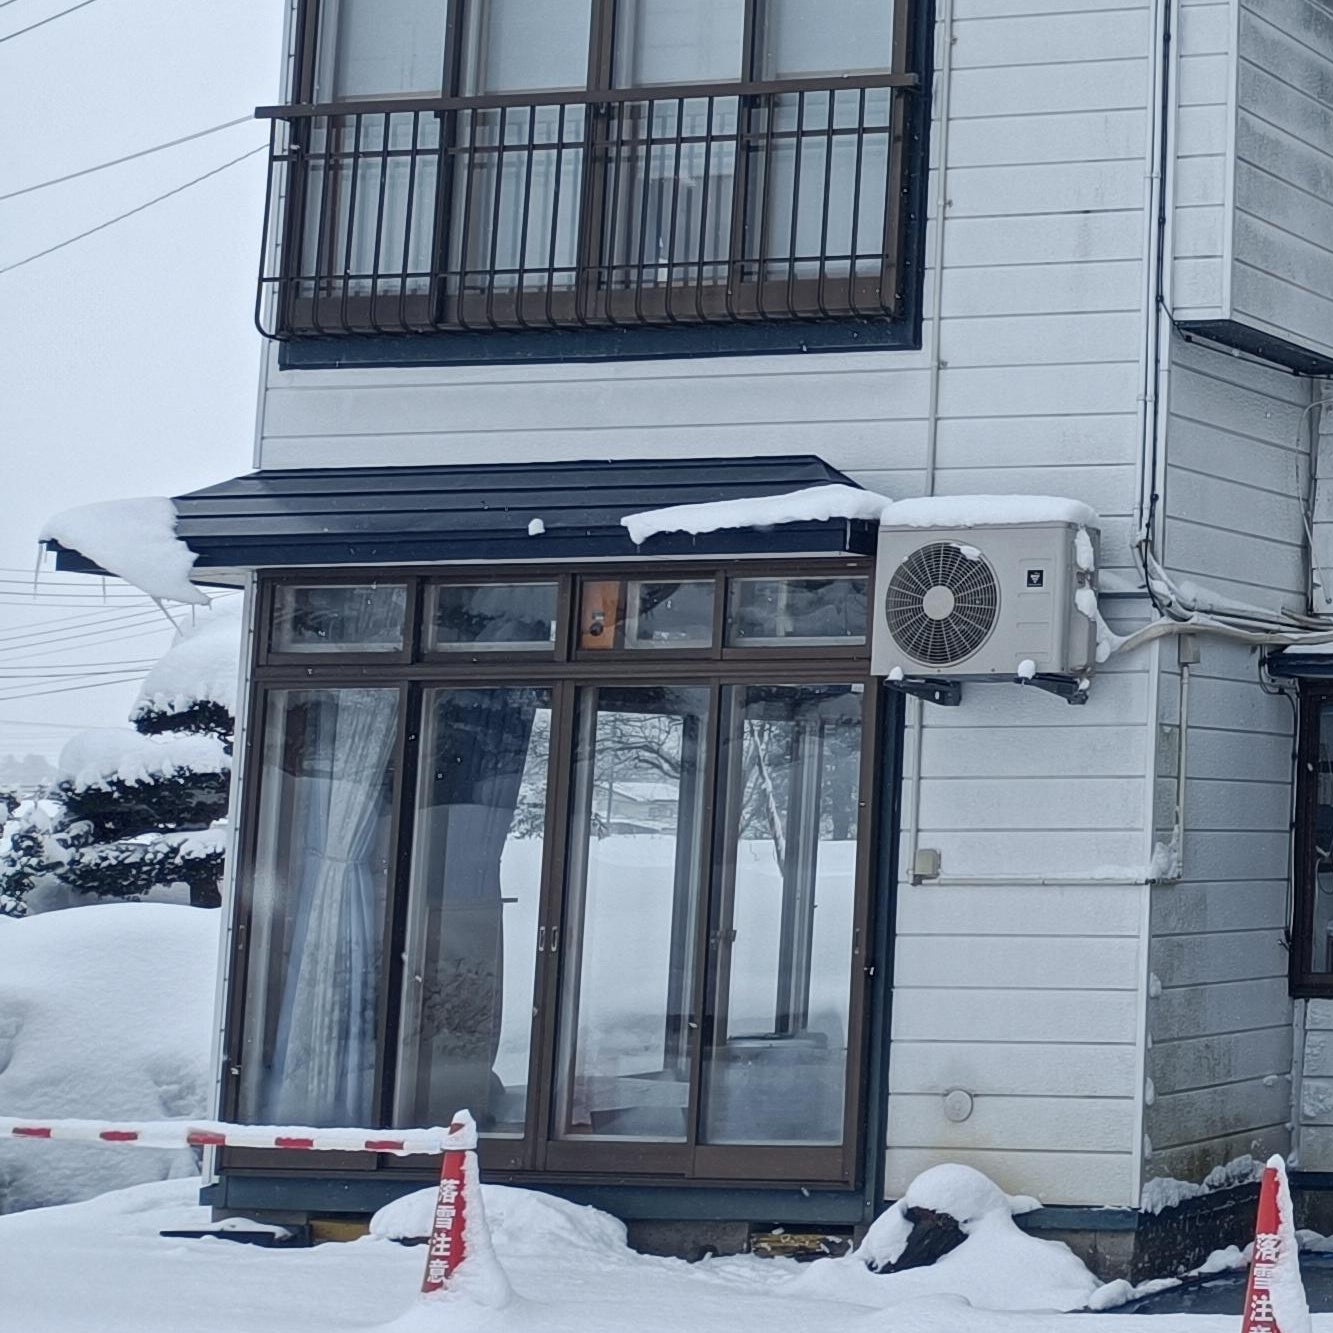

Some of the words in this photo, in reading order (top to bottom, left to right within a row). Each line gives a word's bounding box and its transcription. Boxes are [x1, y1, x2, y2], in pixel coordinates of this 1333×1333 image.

[427, 1178, 460, 1283] 落雪注意
[1249, 1232, 1281, 1333] 落雪注
